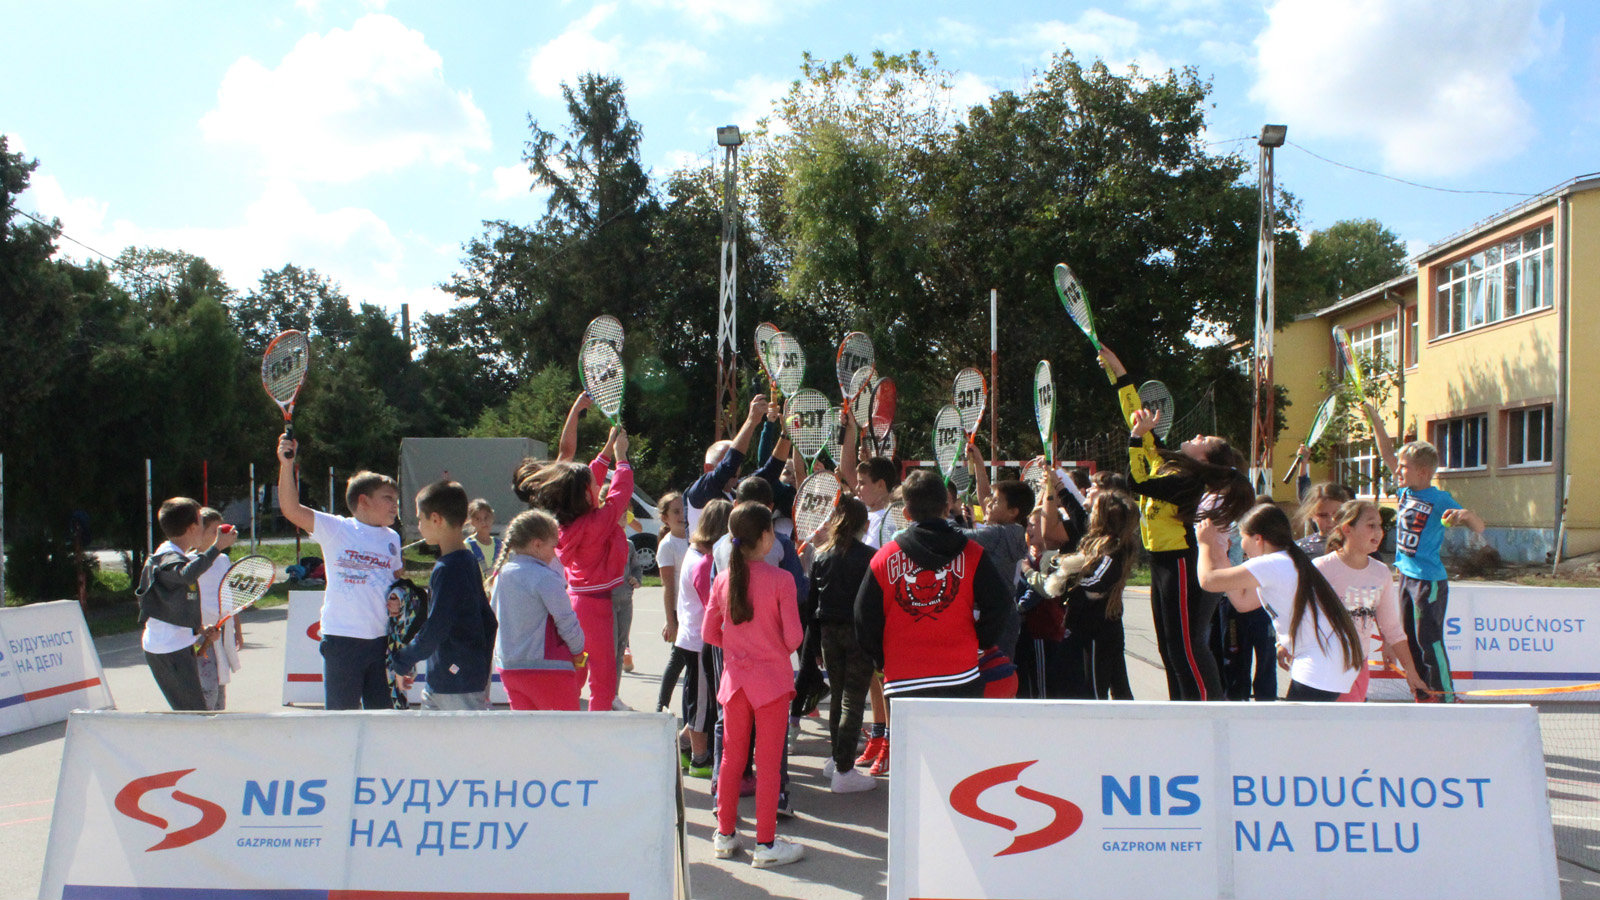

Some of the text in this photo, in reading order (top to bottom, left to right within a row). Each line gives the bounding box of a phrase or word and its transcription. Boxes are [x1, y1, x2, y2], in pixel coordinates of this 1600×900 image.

[1474, 615, 1585, 633] BUDUĆNOST
[9, 630, 74, 655] БУДУЋНОСТ
[1475, 637, 1554, 652] NA DELU
[16, 652, 63, 673] НА ДЕЛУ
[242, 780, 327, 816] NIS
[354, 777, 598, 813] БУДУЋНОСТ
[1101, 775, 1201, 816] NIS
[1233, 769, 1491, 808] BUDUĆNOST
[237, 838, 322, 848] GAZPROM NEFT
[350, 819, 528, 856] НА ДЕЛУ
[1102, 841, 1202, 852] GAZPROM NEFT
[1235, 821, 1420, 853] NA DELU
